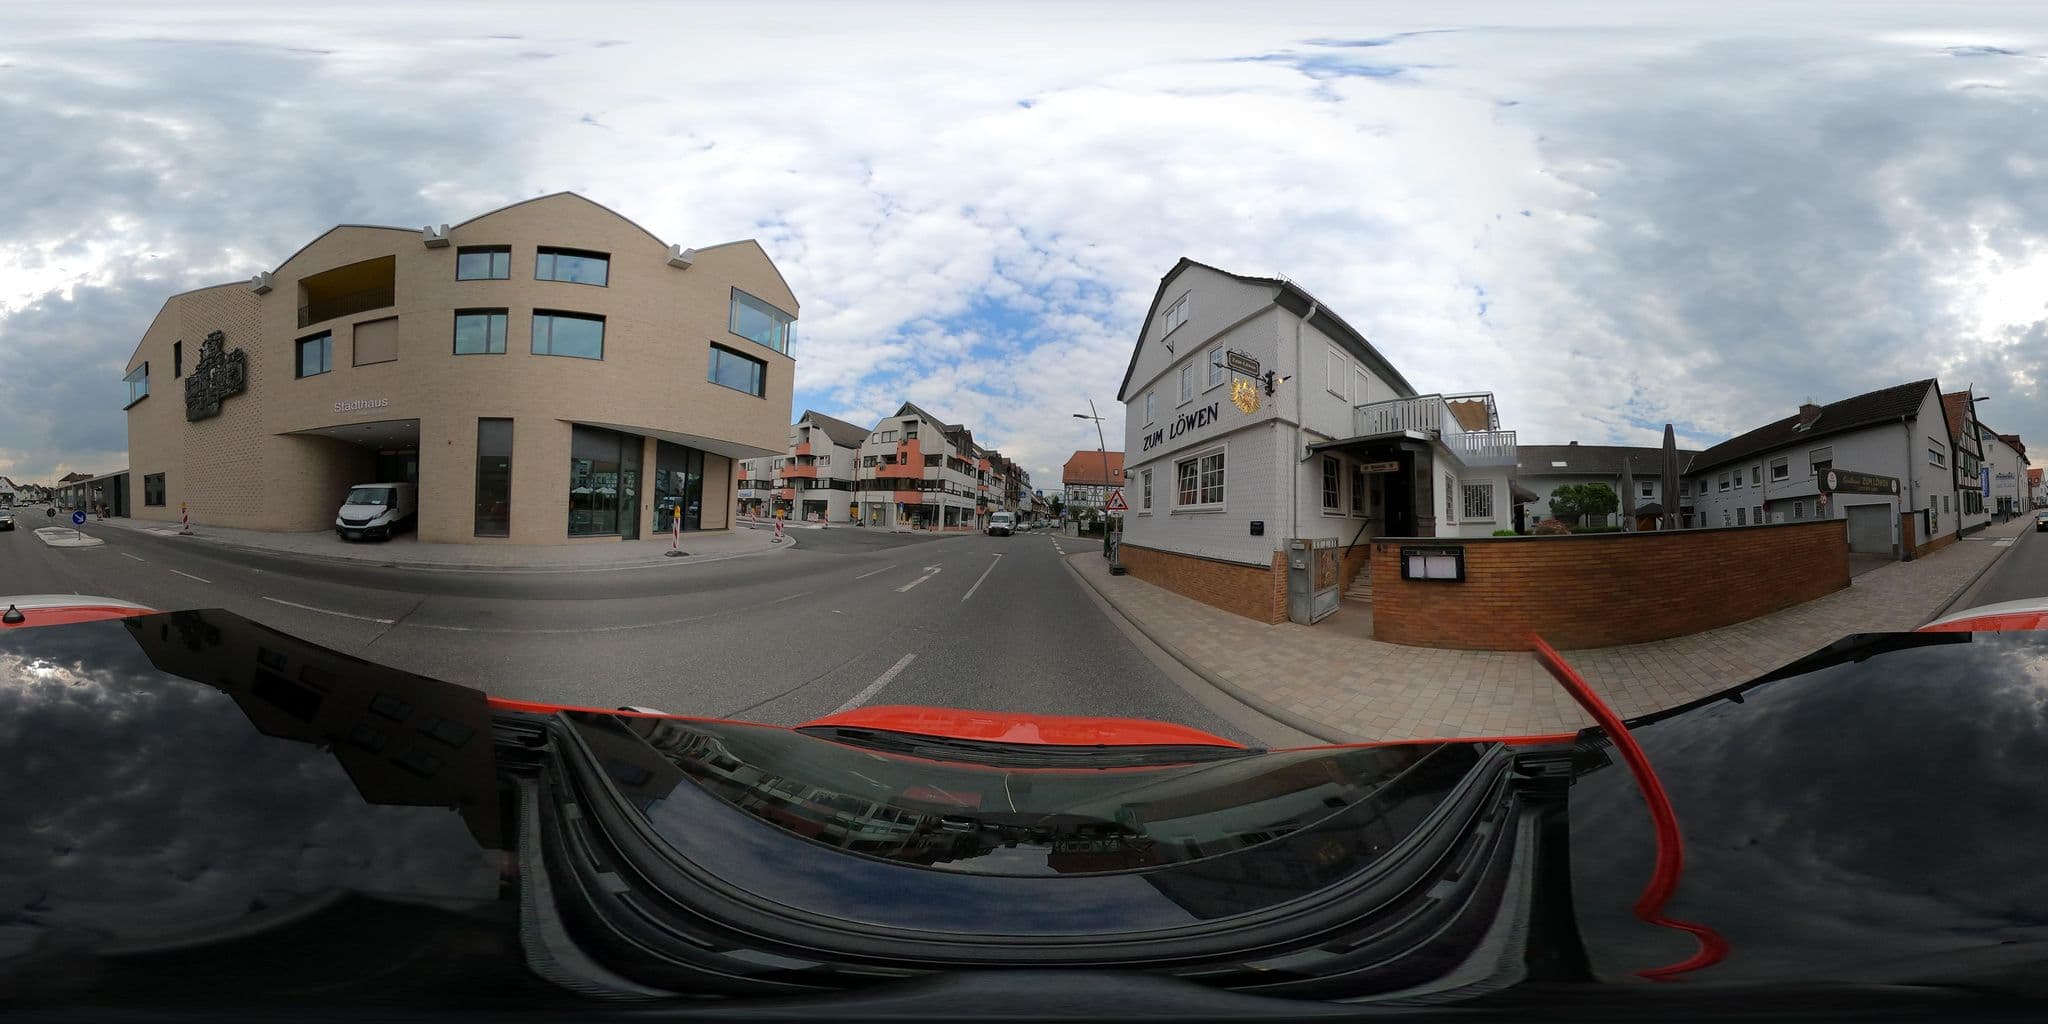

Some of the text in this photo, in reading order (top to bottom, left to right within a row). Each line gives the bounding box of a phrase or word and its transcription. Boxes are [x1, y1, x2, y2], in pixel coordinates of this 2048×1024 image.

[334, 399, 388, 412] Stadthaus
[1143, 402, 1218, 451] ZUM LÖWEN
